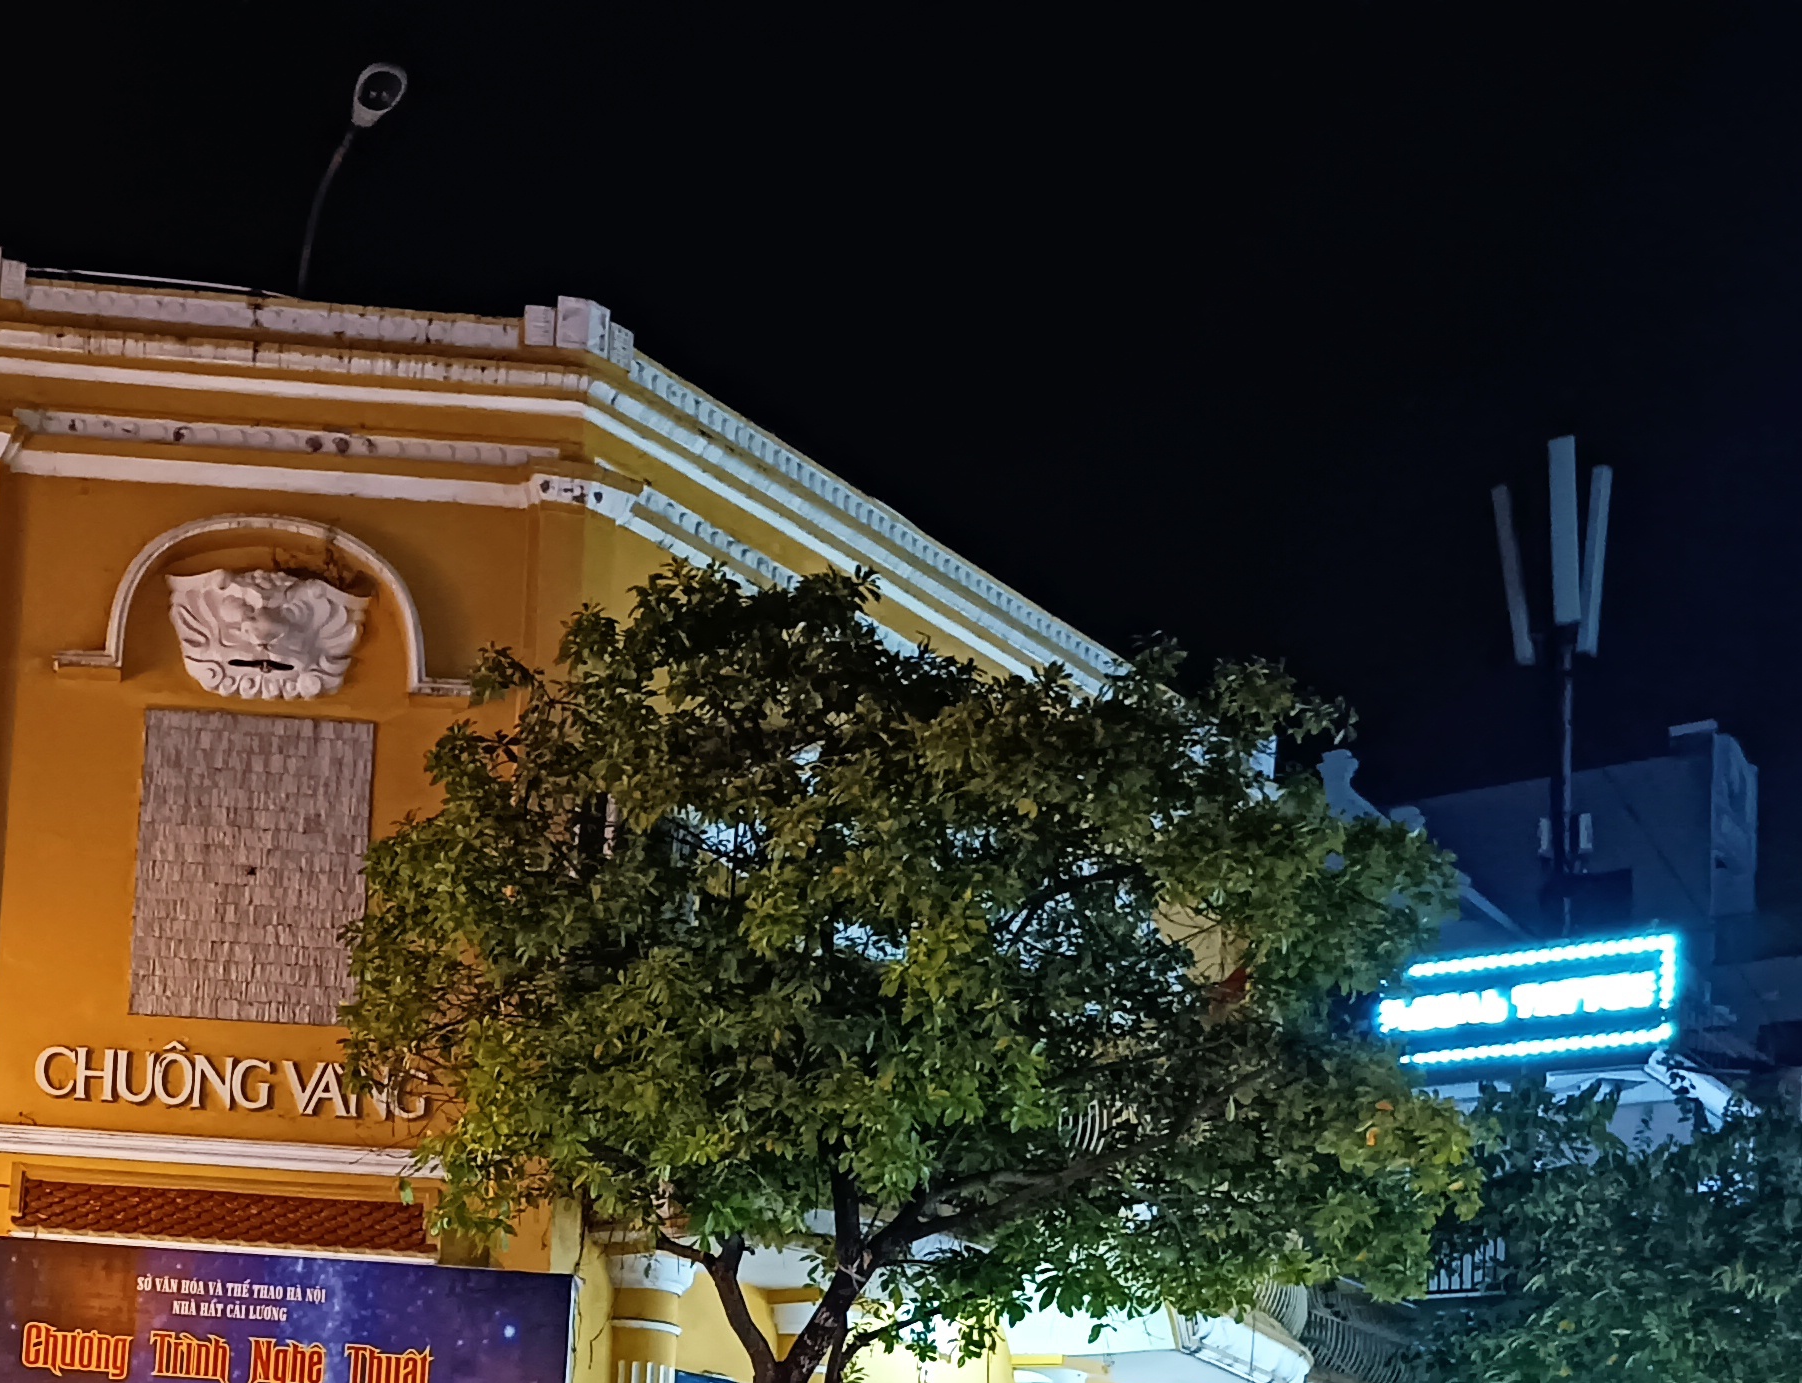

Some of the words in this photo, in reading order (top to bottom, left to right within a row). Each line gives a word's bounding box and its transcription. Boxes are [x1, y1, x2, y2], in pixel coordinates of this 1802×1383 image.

[34, 1040, 274, 1110] CHUÔNG
[154, 1275, 178, 1293] VĂN
[180, 1277, 205, 1295] HÓA
[208, 1279, 223, 1296] VÀ
[252, 1284, 284, 1300] THAO
[286, 1284, 303, 1302] HÀ
[305, 1286, 326, 1305] NỘI
[172, 1298, 197, 1315] NHÀ
[226, 1300, 246, 1319] CẢI
[248, 1304, 288, 1322] LƯƠNG
[21, 1321, 134, 1381] Chương
